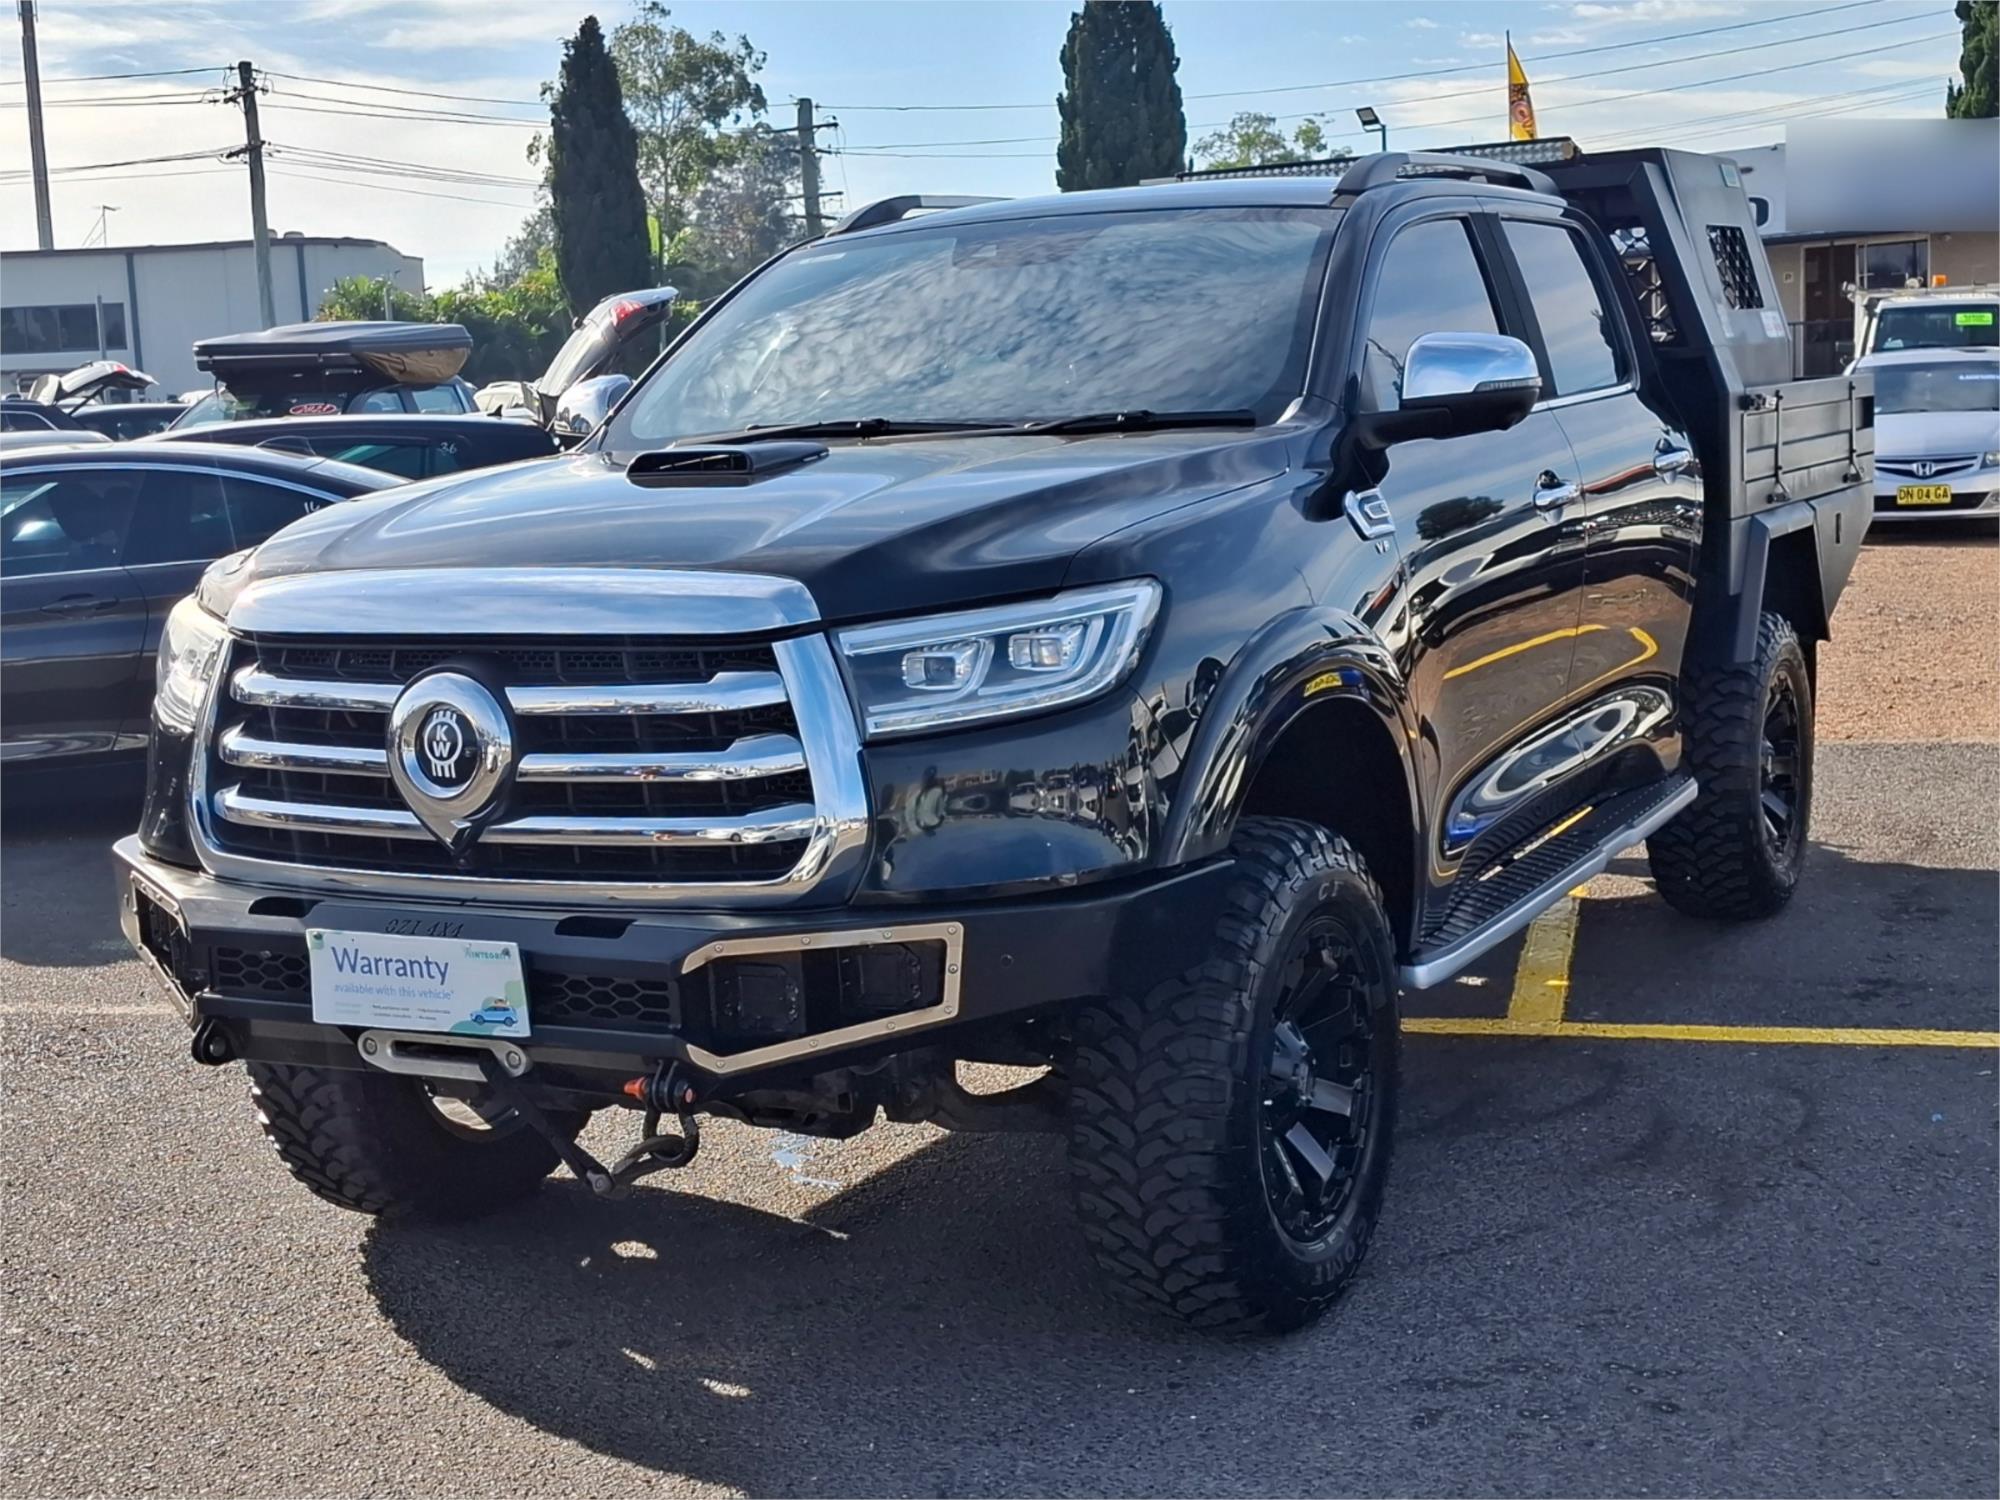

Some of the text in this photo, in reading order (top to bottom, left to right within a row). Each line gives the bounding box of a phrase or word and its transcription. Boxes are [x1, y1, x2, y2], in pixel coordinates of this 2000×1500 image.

[330, 946, 449, 986] Warranty
[334, 983, 374, 995] available
[376, 985, 397, 997] with
[399, 986, 417, 998] this
